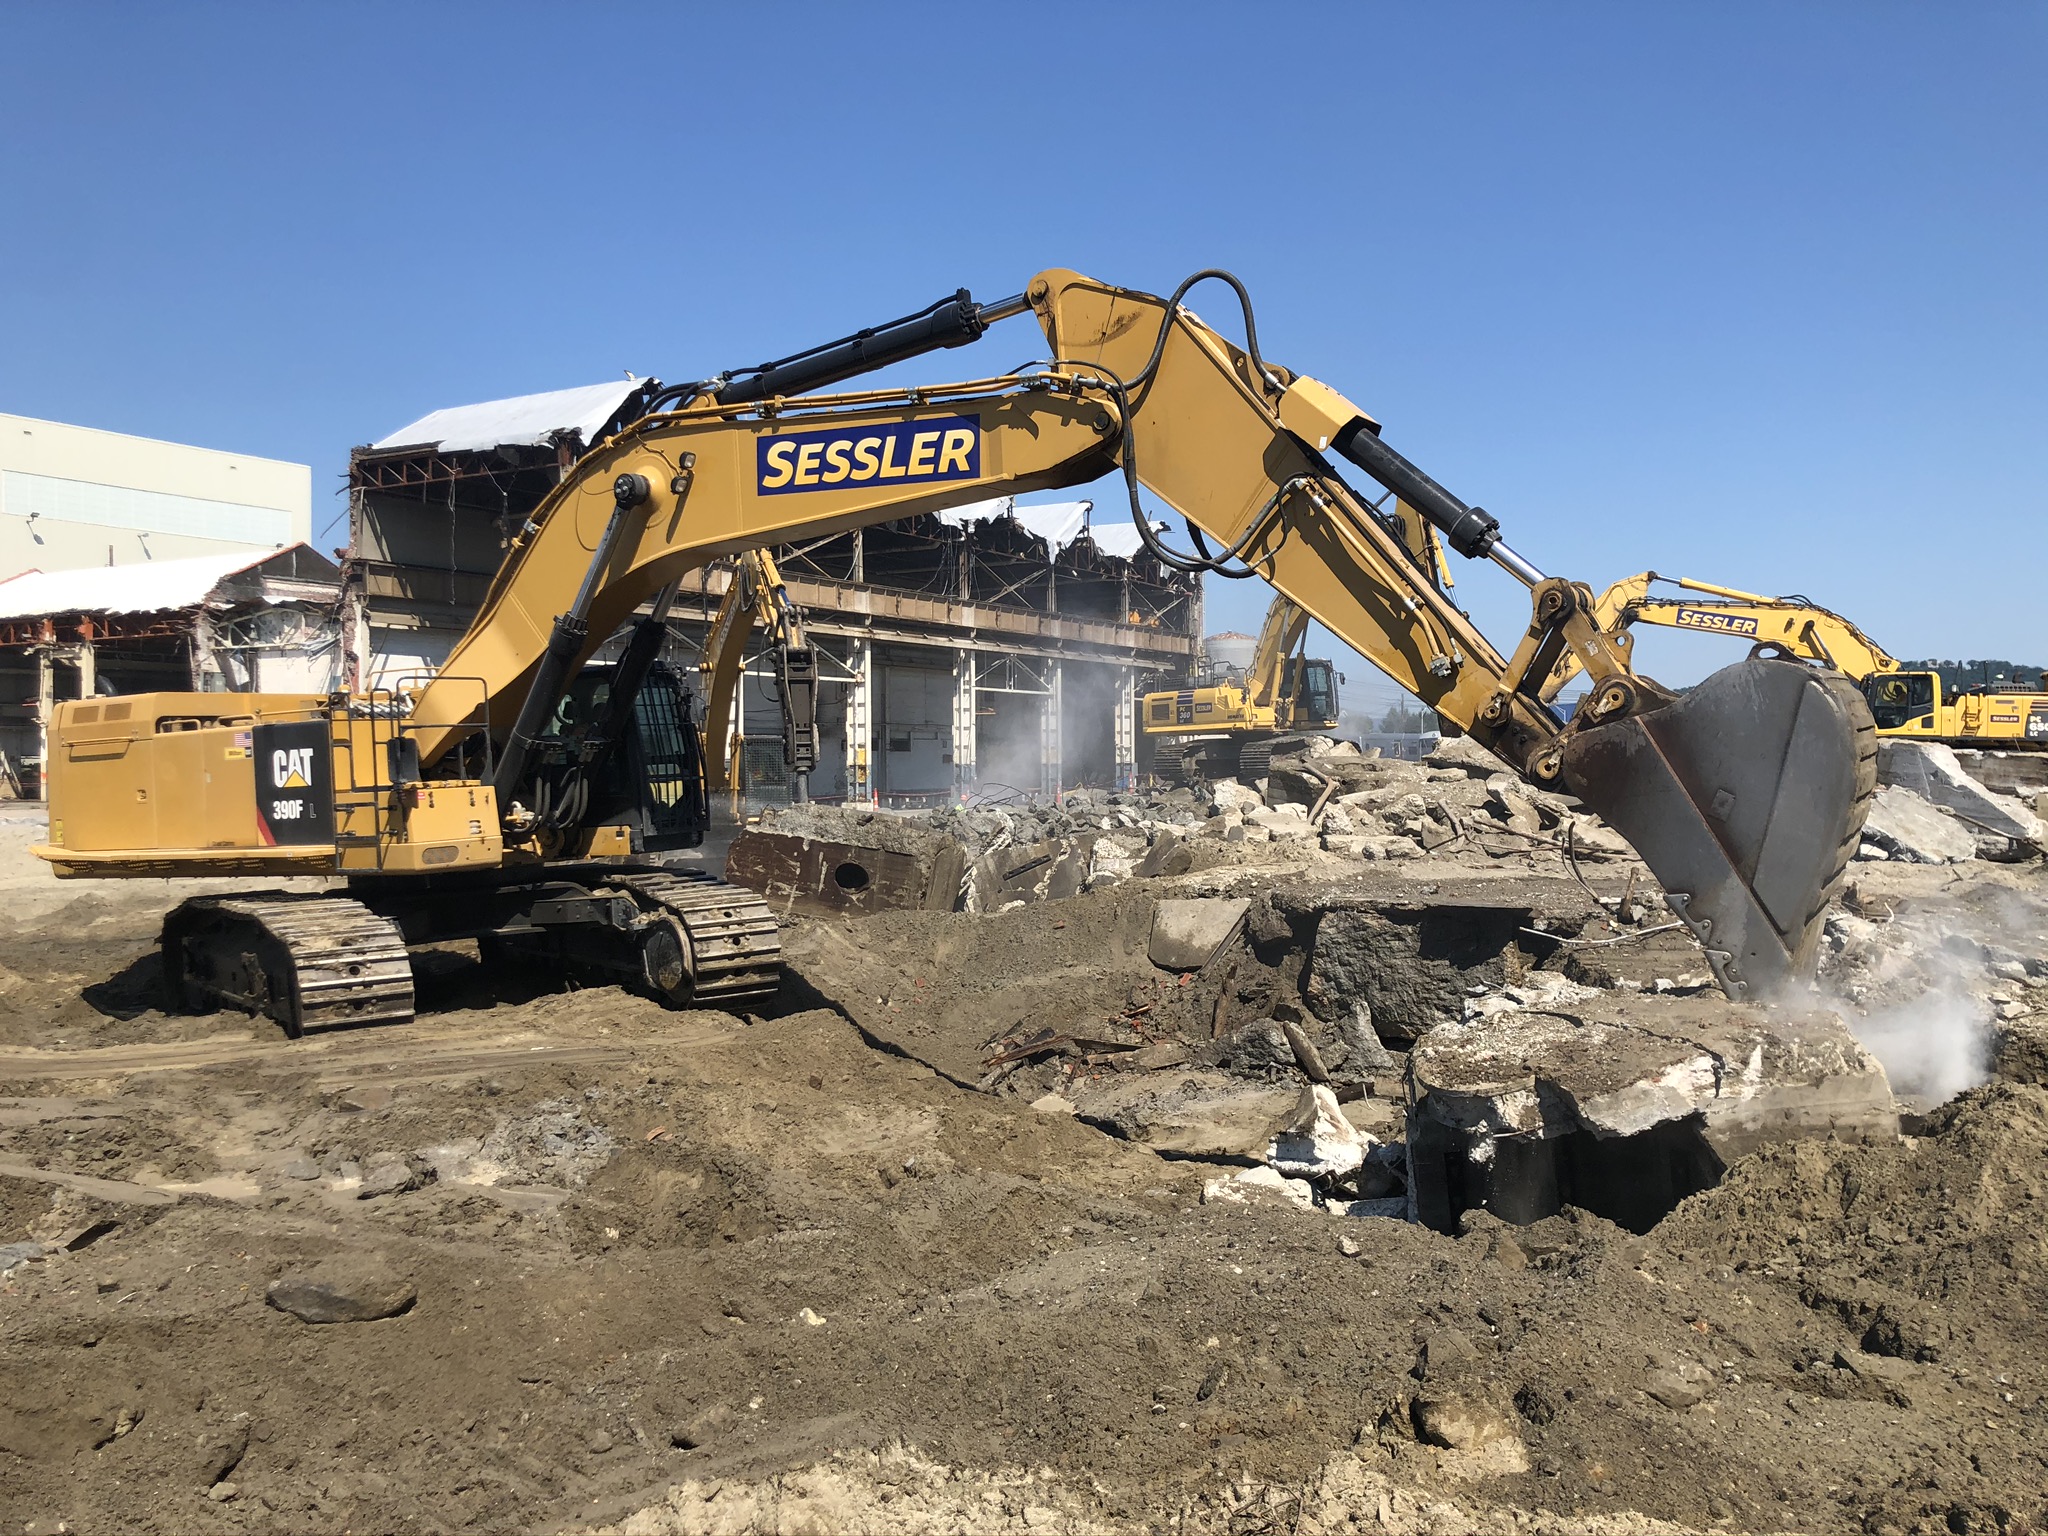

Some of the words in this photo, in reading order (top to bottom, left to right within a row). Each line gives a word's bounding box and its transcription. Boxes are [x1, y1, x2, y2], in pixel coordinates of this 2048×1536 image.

[762, 428, 976, 488] SESSLER
[1678, 611, 1756, 633] SESSLER
[1179, 711, 1190, 719] 360
[273, 748, 314, 788] CAT
[273, 799, 303, 819] 390F
[309, 803, 317, 818] L
